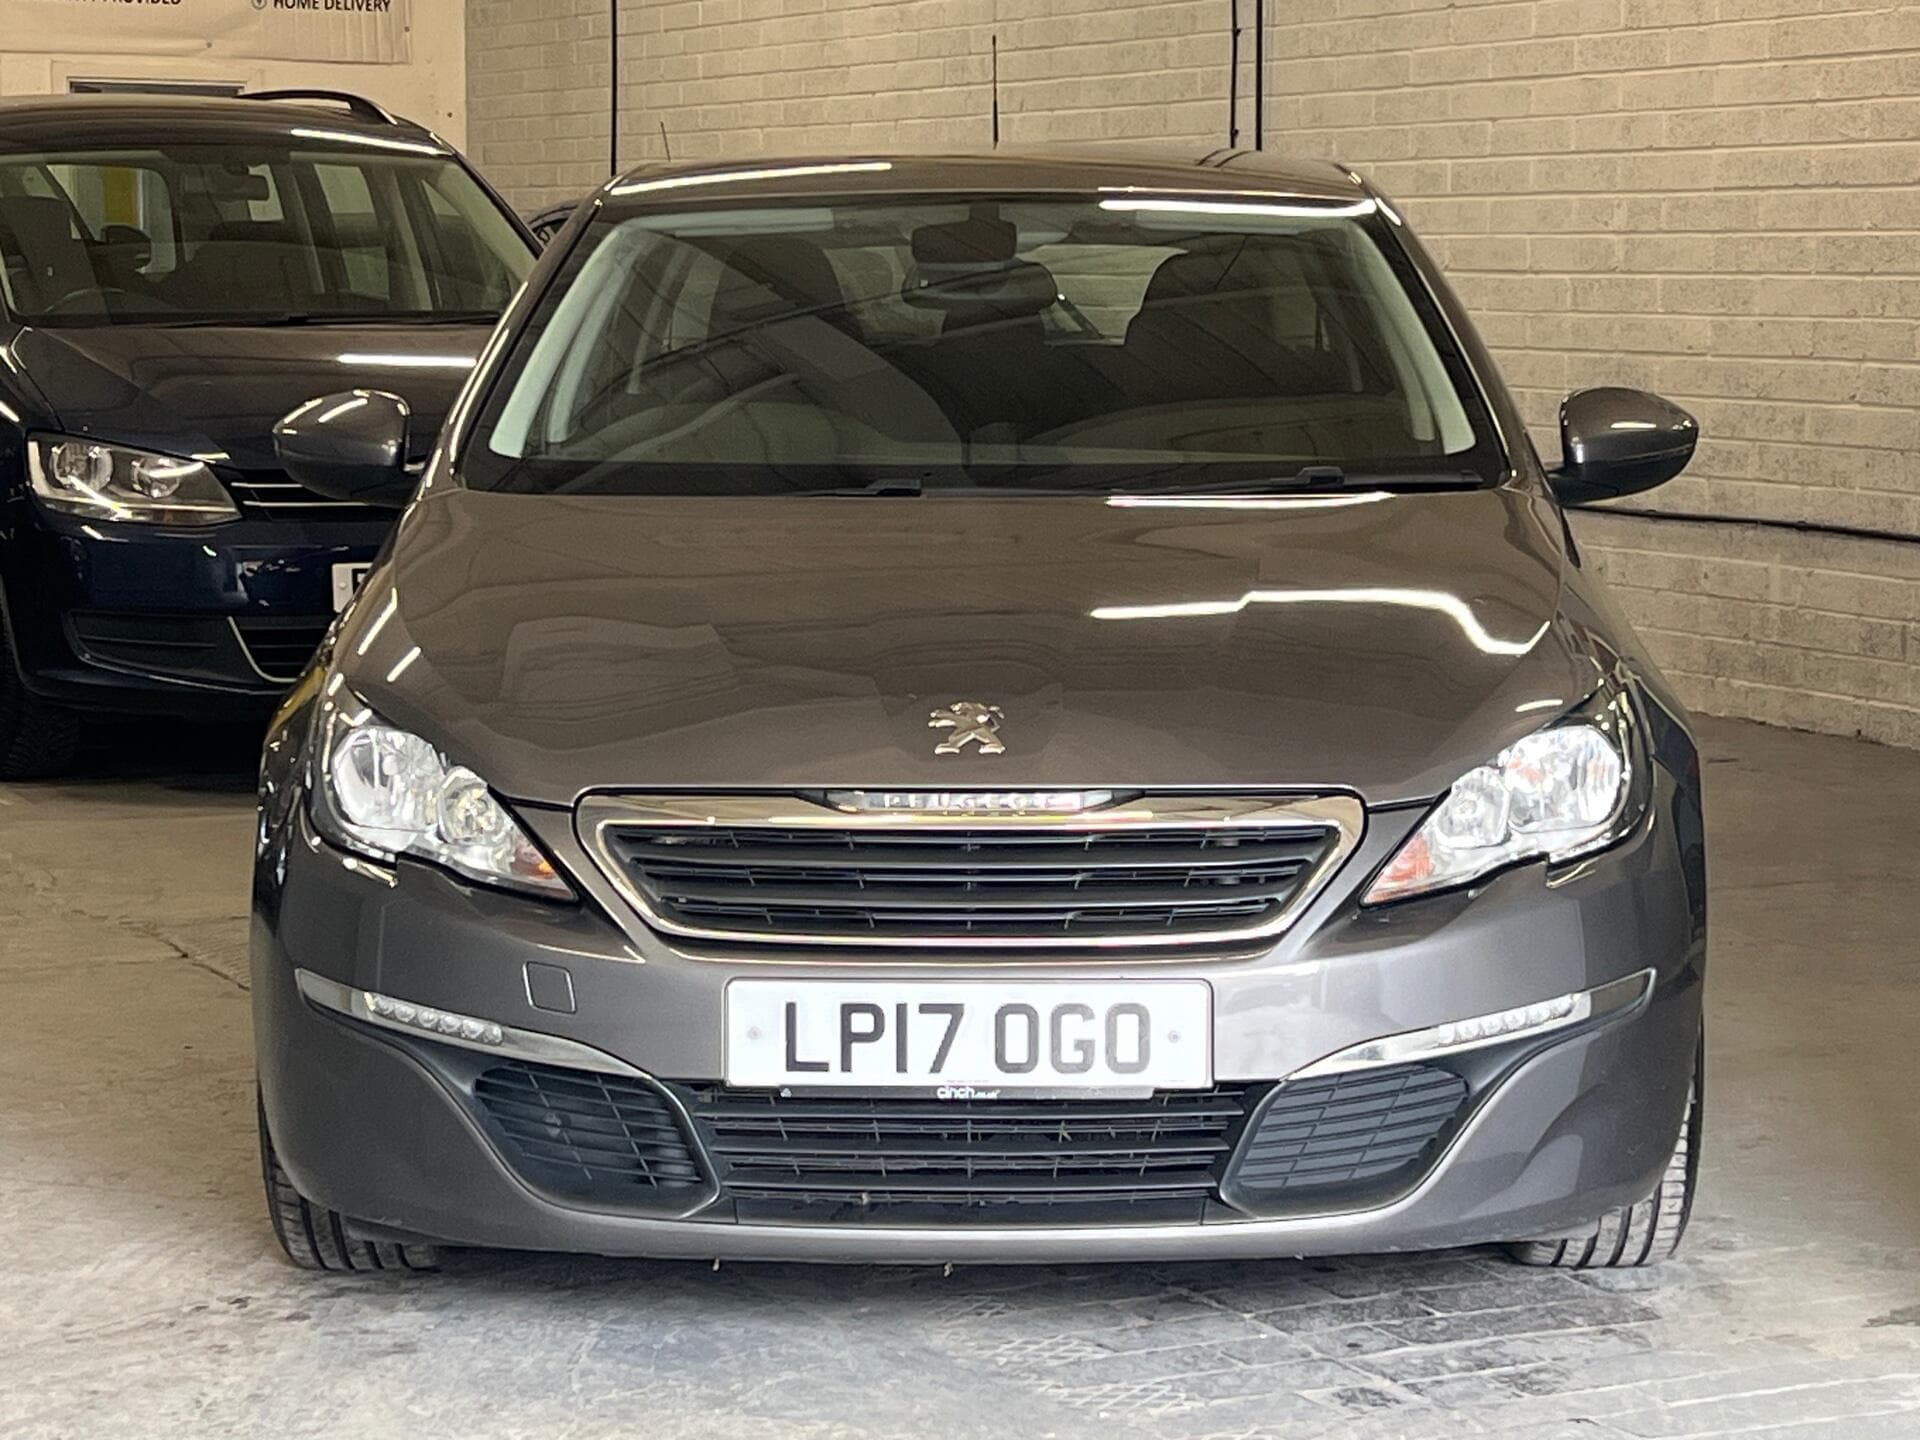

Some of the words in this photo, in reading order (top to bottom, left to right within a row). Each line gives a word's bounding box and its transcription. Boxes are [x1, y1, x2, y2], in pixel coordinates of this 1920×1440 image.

[273, 0, 319, 10] HOME
[324, 0, 390, 12] DELIVERY
[785, 1002, 964, 1074] LP17
[994, 1002, 1151, 1074] OGO
